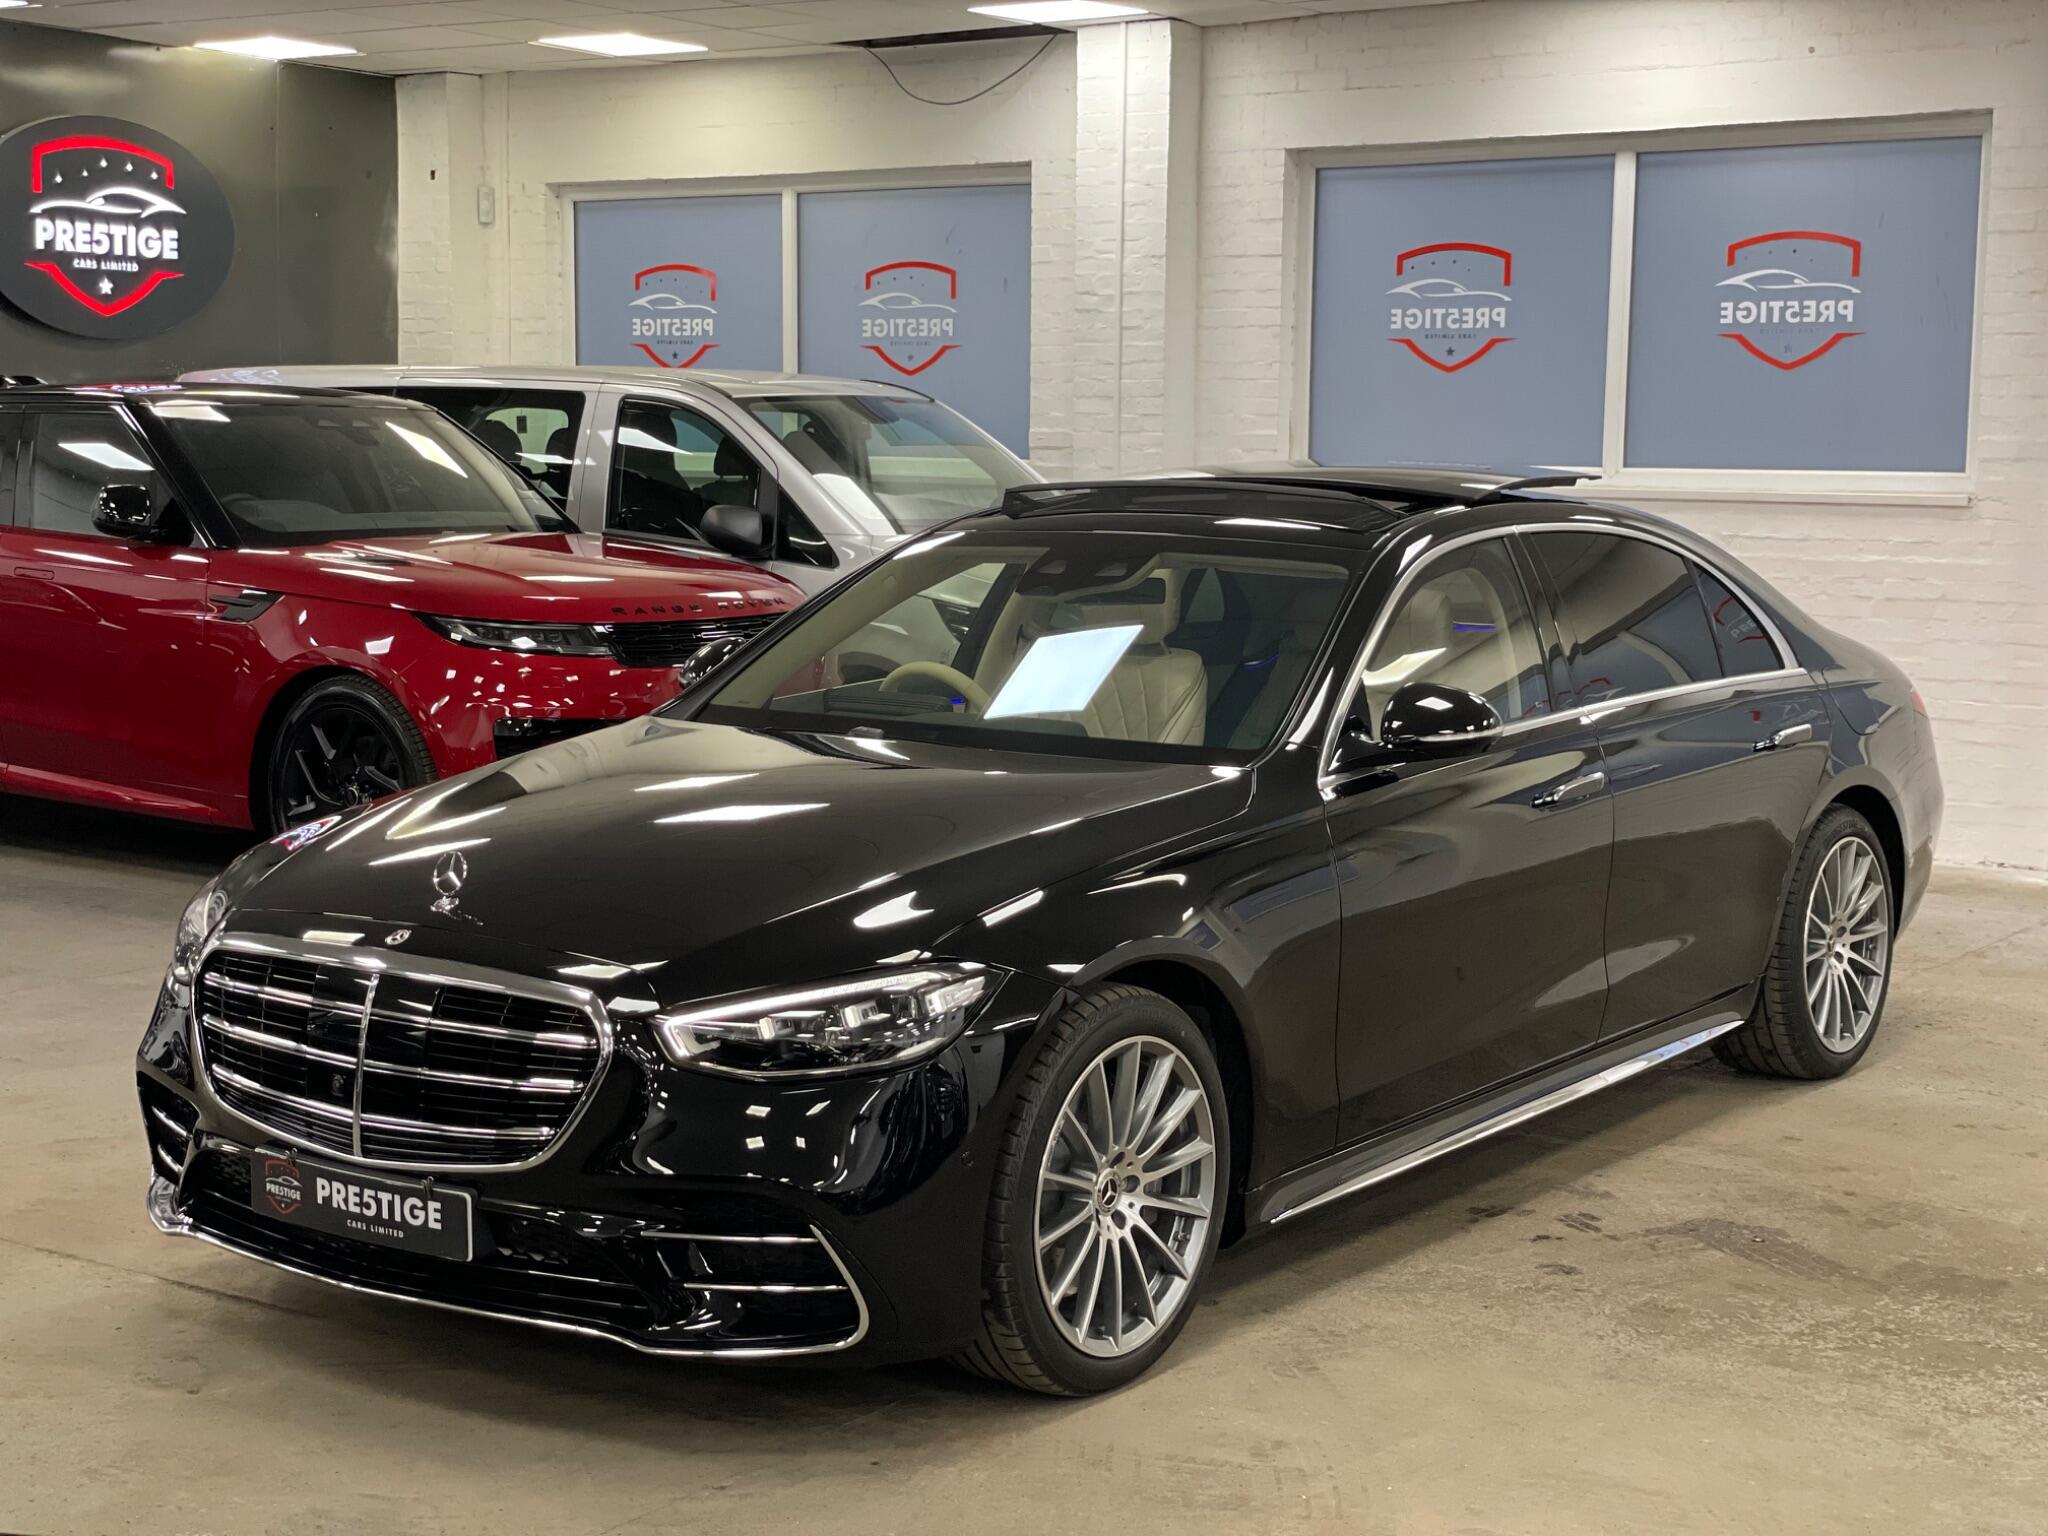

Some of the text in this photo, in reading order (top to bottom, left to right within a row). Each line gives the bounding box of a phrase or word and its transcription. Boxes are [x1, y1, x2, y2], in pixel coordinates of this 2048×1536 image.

[73, 258, 139, 272] CARS LIMITED
[611, 603, 703, 616] RANGE
[347, 1219, 404, 1239] CARS LIMITED
